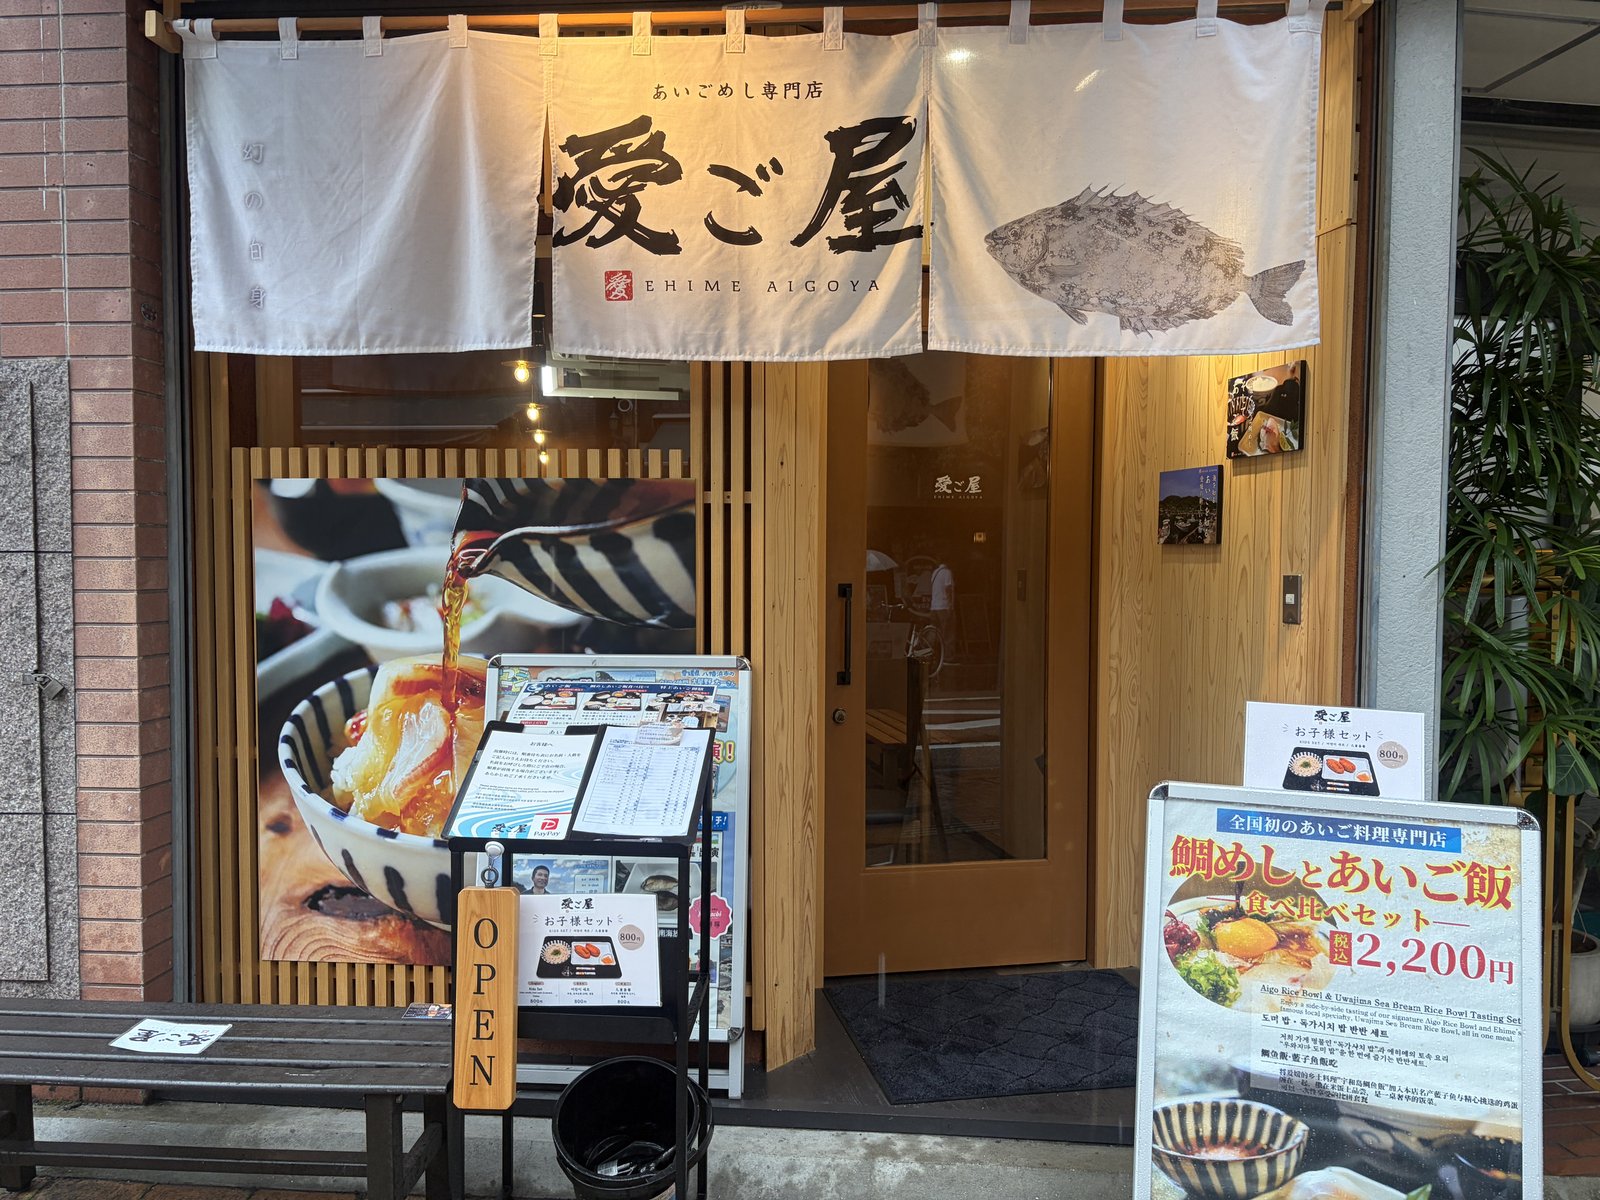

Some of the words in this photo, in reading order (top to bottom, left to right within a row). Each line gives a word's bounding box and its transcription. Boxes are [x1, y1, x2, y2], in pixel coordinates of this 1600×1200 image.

[652, 81, 824, 101] あいごめし専門店
[552, 115, 924, 255] 愛ご屋
[242, 143, 266, 308] 幻の白身
[645, 280, 741, 292] EHIME
[767, 279, 880, 292] AIGOYA
[934, 475, 982, 494] 愛ご屋
[1314, 709, 1351, 723] 愛ご屋
[1295, 726, 1372, 742] お子様セット
[1379, 750, 1403, 760] 800円
[1229, 814, 1447, 848] 全国初のあいご料理専門店
[1169, 834, 1512, 911] 鯛めしとあいご飯
[561, 897, 594, 910] 愛ご屋
[1247, 891, 1434, 932] 食べ比べセット
[545, 915, 613, 926] お子様セット
[620, 933, 641, 942] 800円
[1332, 932, 1349, 963] 税込
[1357, 934, 1514, 985] 2,200円
[469, 918, 498, 1086] OPEN
[1260, 985, 1279, 994] Aigo
[1281, 987, 1299, 996] Rice
[1302, 990, 1322, 999] Bowl
[1335, 994, 1372, 1005] Uwajima
[1375, 999, 1390, 1008] Sea
[1392, 1002, 1421, 1012] Bream
[1424, 1005, 1443, 1014] Rice
[1446, 1008, 1468, 1018] Bowl
[1470, 1011, 1503, 1024] Tasting
[1506, 1016, 1521, 1024] Set
[1280, 999, 1298, 1007] Enjoy
[1306, 1003, 1344, 1013] side-by-side
[1346, 1008, 1368, 1017] tasting
[1392, 1014, 1424, 1024] signature
[1425, 1017, 1441, 1026] Aigo
[1443, 1020, 1458, 1028] Rice
[1460, 1022, 1477, 1030] Bowl
[1262, 1014, 1279, 1024] 도미
[1282, 1016, 1291, 1025] 밥
[1300, 1019, 1335, 1032] 독가시치
[1338, 1023, 1347, 1033] 밥
[1350, 1025, 1368, 1036] 반반
[1370, 1028, 1389, 1038] 세트
[1280, 1006, 1303, 1015] famous
[1305, 1009, 1320, 1017] local
[1354, 1016, 1384, 1026] Uwajima
[1399, 1021, 1422, 1030] Bream
[1424, 1024, 1439, 1032] Rice
[1441, 1027, 1460, 1036] Bowl,
